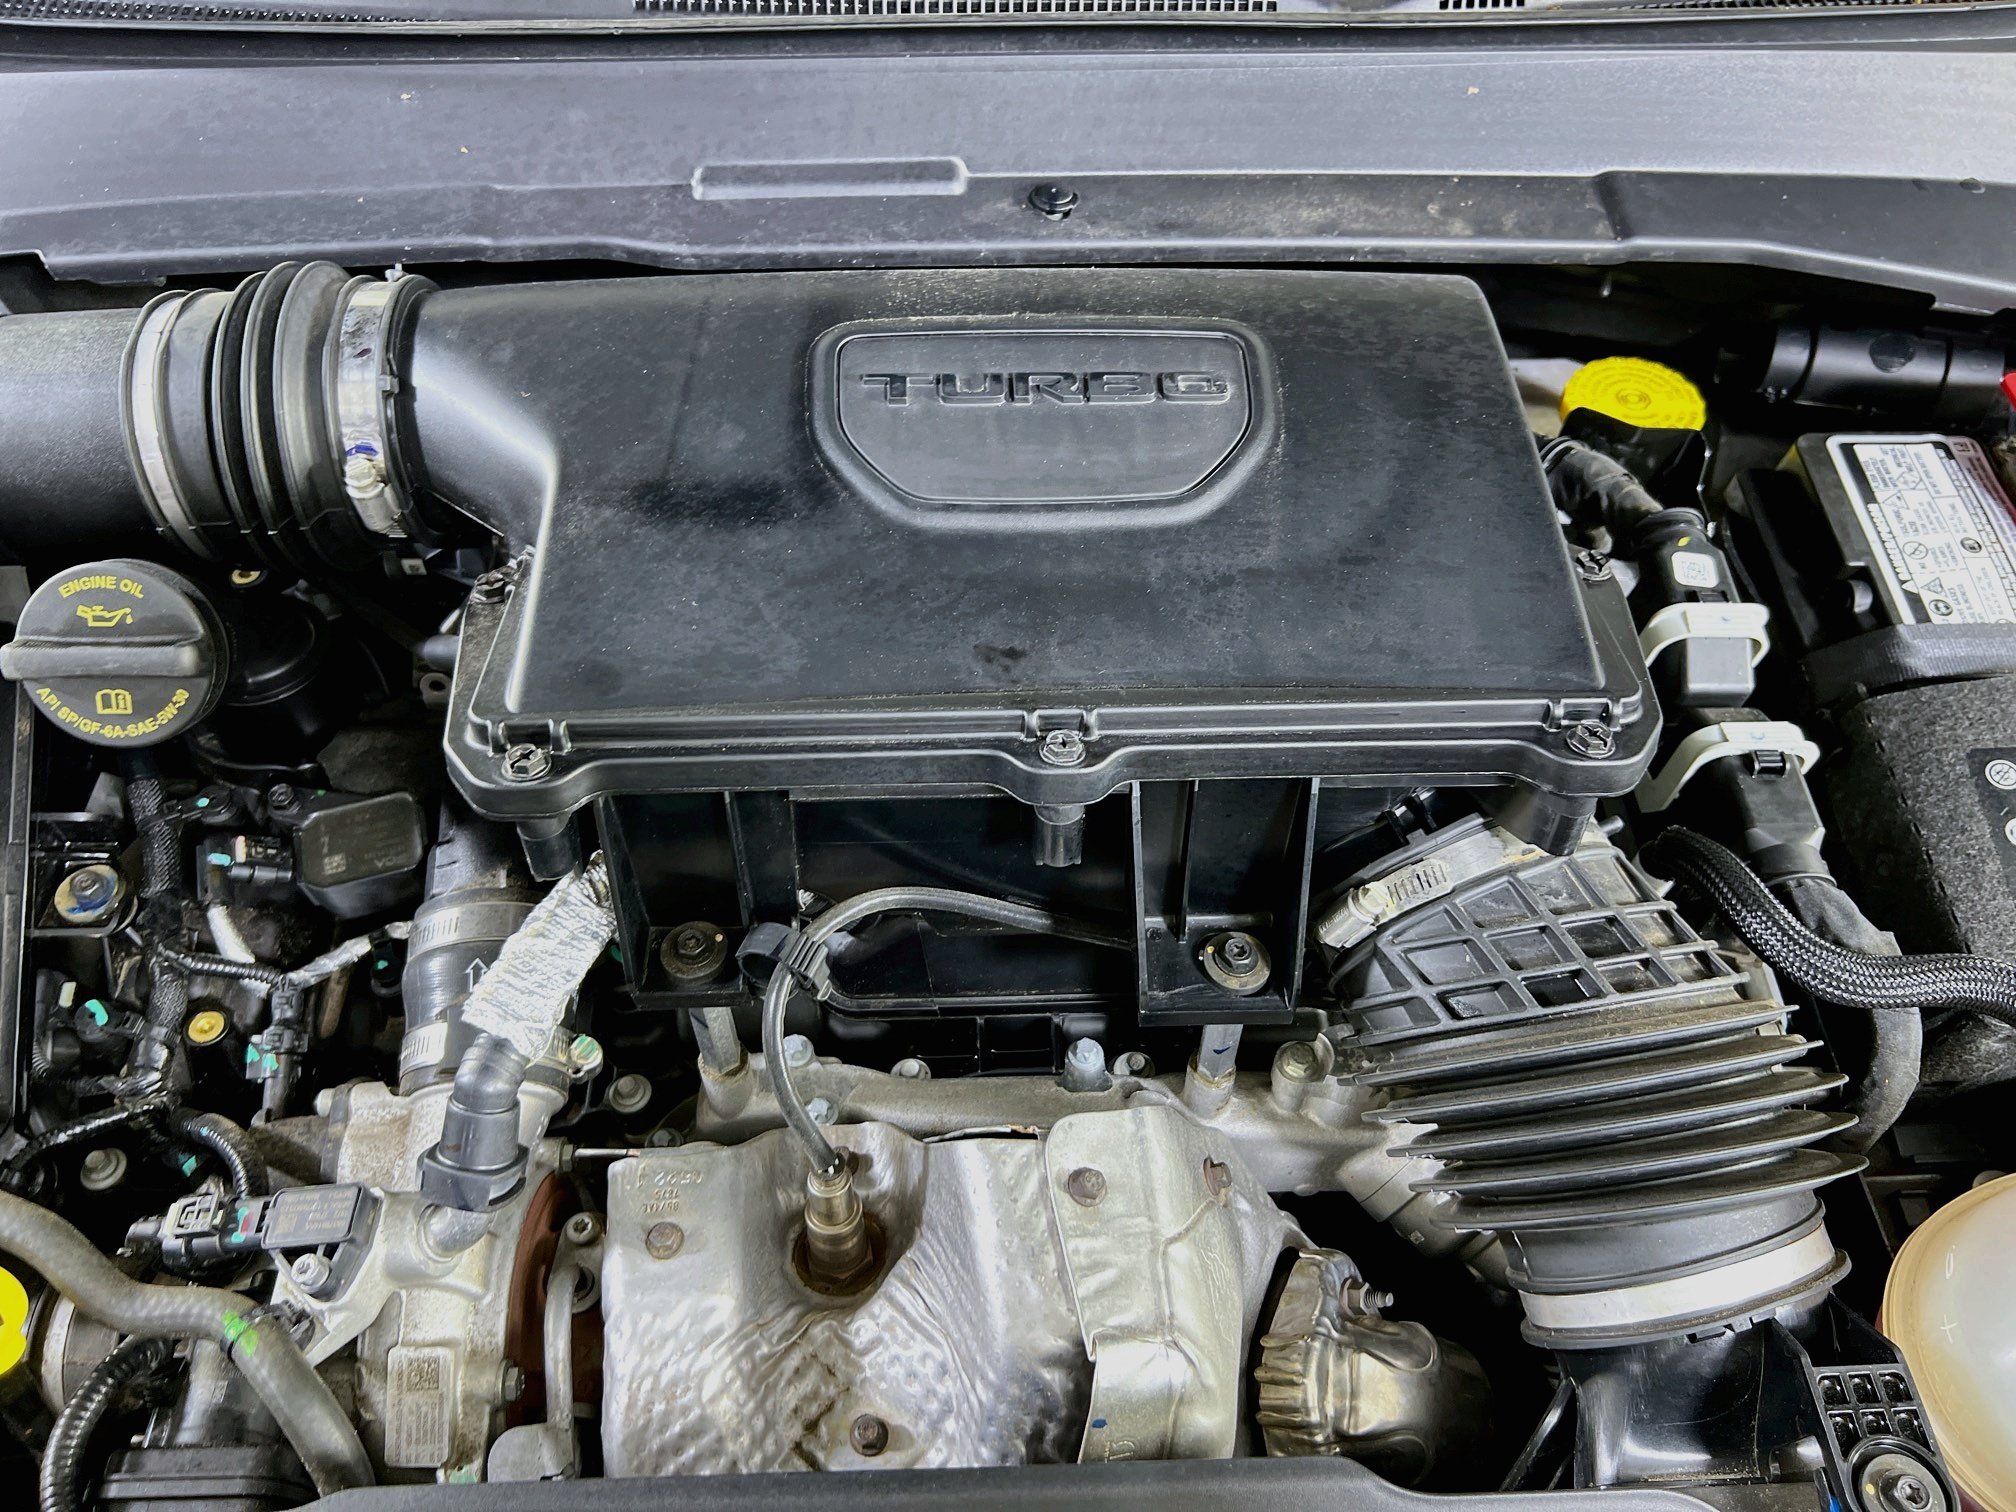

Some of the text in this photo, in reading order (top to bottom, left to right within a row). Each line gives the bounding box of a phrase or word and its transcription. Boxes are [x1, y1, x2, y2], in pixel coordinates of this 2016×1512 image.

[860, 371, 1232, 406] TURBO
[58, 575, 145, 599] ENGINE OIL
[36, 687, 61, 710] API
